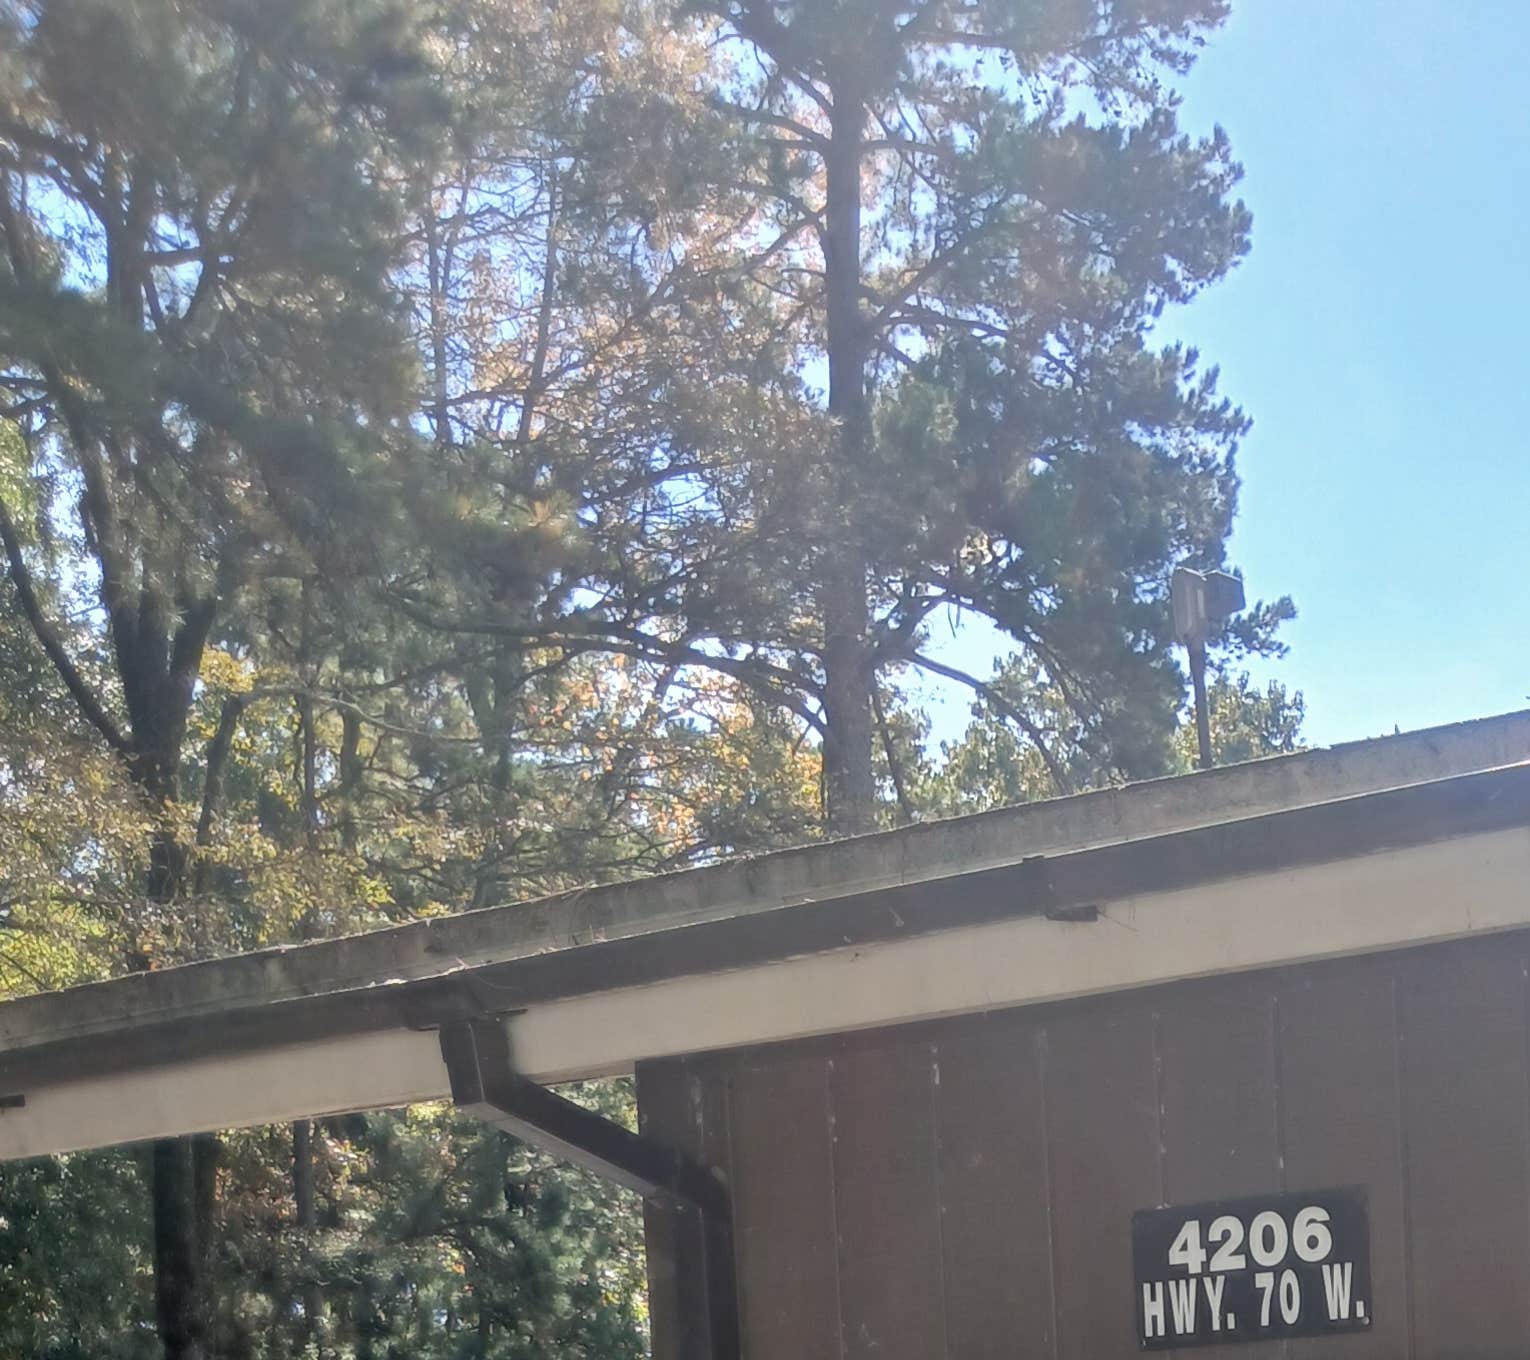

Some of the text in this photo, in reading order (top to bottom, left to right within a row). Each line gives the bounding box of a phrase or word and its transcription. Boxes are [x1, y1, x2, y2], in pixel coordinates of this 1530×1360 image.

[1168, 1206, 1332, 1274] 4206
[1143, 1262, 1365, 1337] HWY. 70 W.
